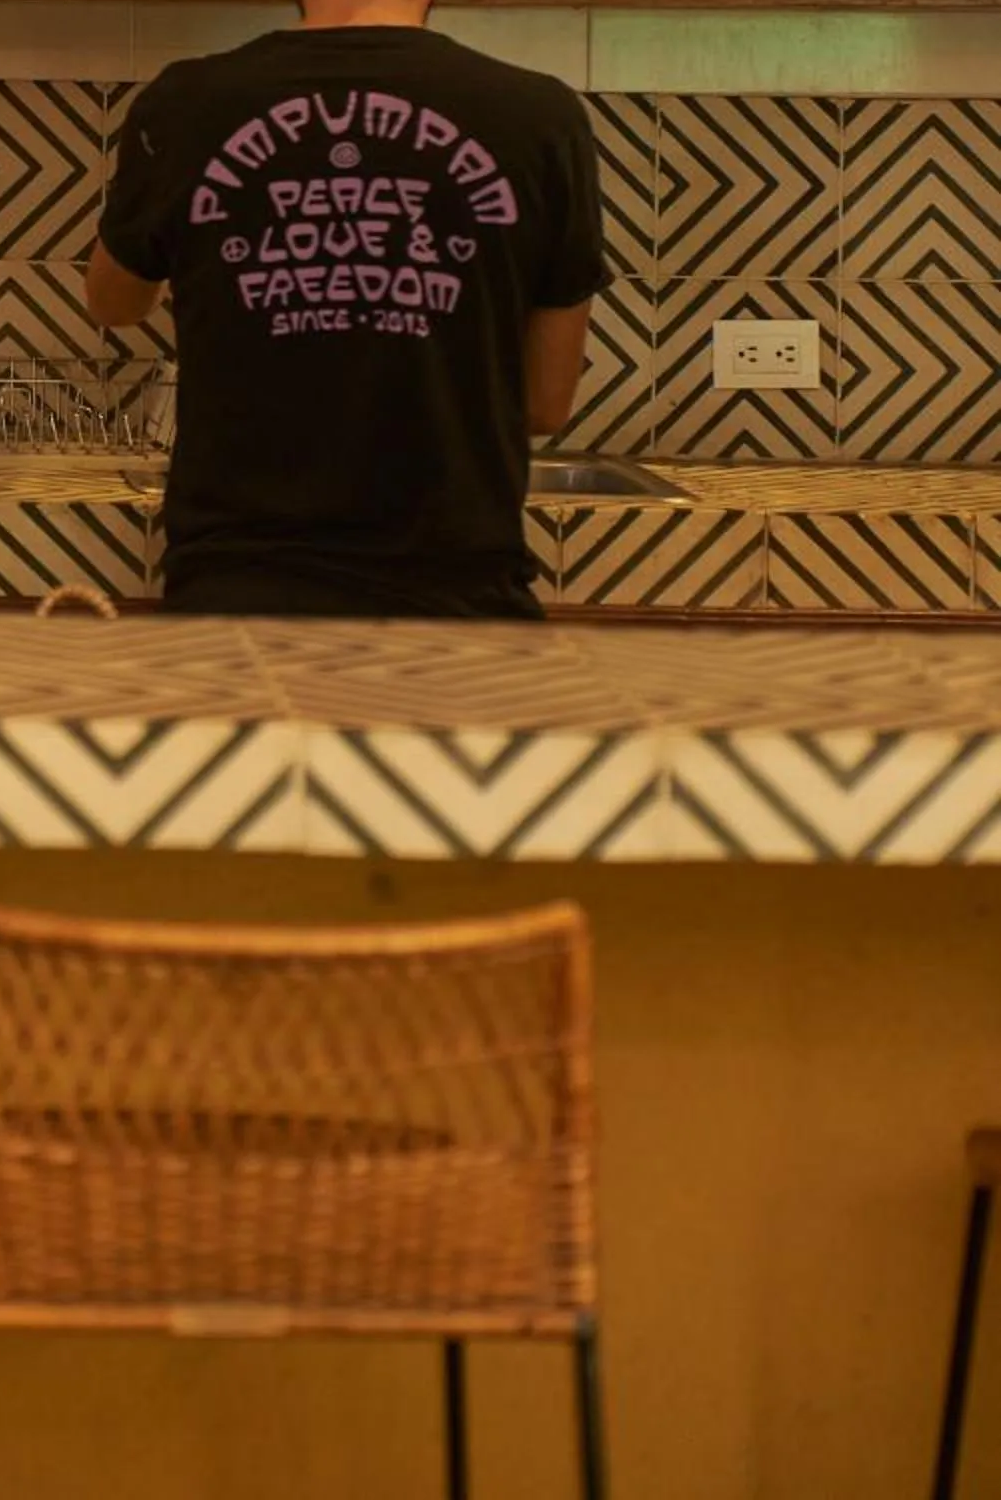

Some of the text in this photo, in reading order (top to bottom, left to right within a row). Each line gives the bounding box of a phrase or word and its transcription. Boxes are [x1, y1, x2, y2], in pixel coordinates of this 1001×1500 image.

[267, 176, 431, 224] PEACE
[258, 220, 440, 264] LOVE &
[238, 264, 462, 313] FREEDOM
